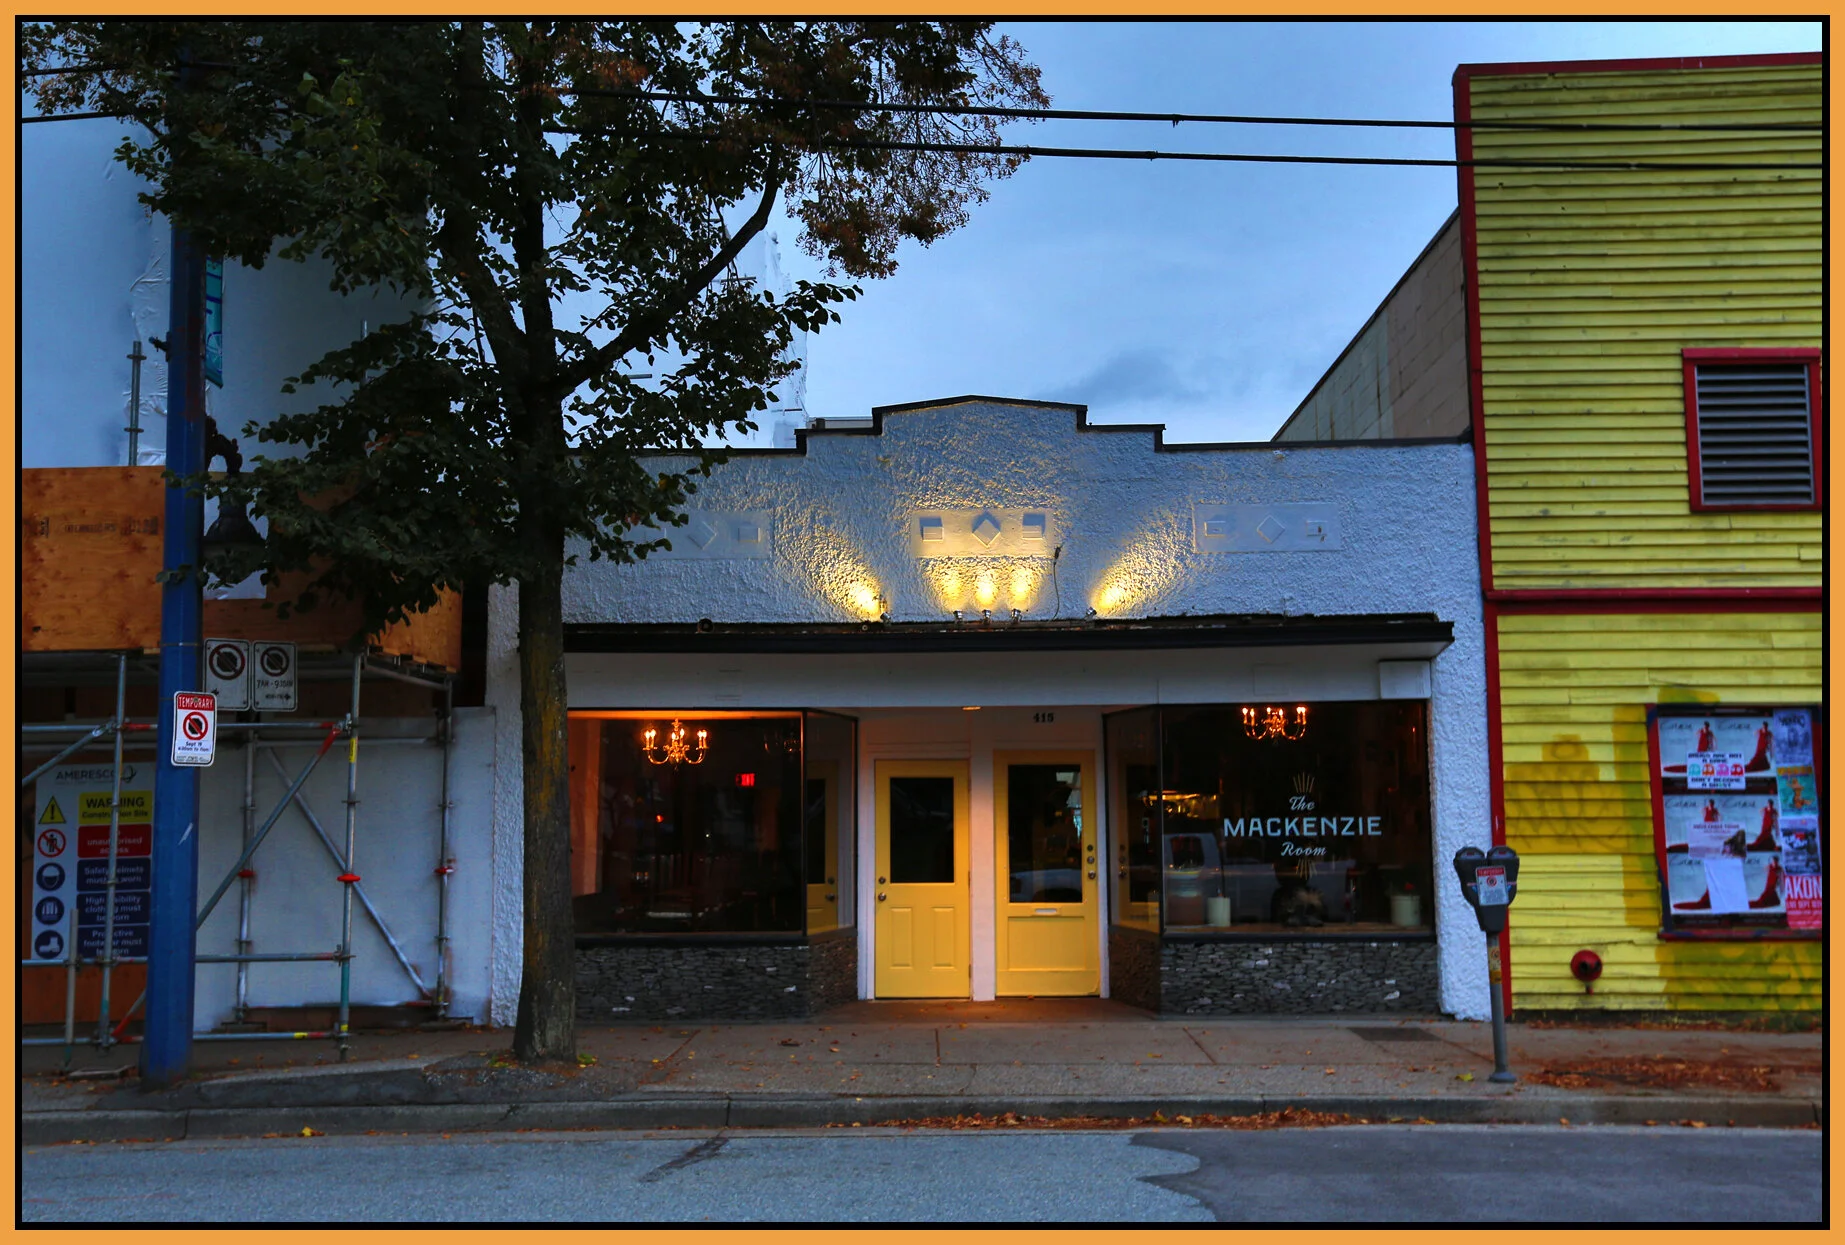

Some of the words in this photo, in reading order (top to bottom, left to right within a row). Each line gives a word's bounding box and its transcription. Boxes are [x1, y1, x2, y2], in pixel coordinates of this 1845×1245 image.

[178, 696, 214, 709] TEMPORARY
[1289, 795, 1316, 811] The
[1223, 816, 1382, 837] MACKENZIE
[1280, 841, 1327, 857] Room
[115, 865, 144, 874] elmets
[1784, 876, 1822, 899] AKON
[85, 895, 105, 905] High
[121, 904, 141, 913] must
[121, 937, 142, 946] must
